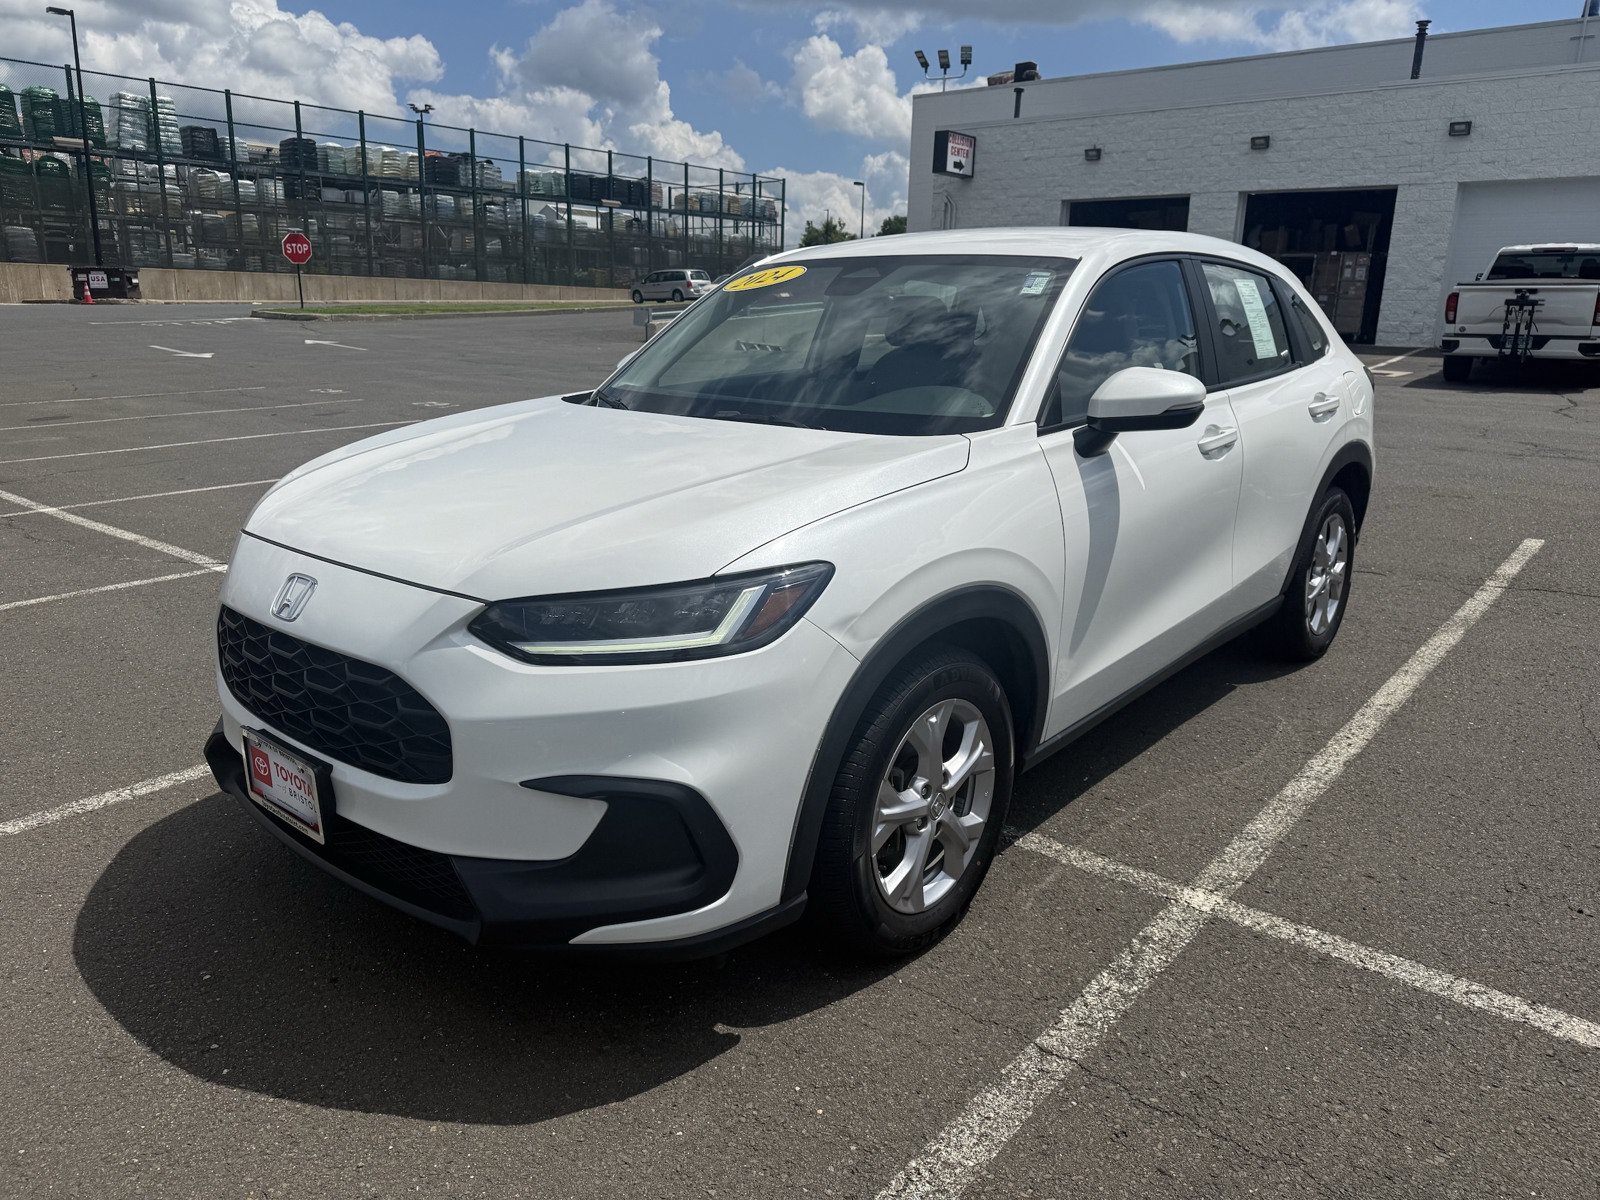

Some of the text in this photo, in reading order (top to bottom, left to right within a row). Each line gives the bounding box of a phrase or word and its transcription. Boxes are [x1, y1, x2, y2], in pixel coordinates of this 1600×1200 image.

[949, 133, 973, 149] COLLISION
[951, 146, 969, 159] CENTER
[286, 243, 309, 254] STOP
[731, 268, 797, 289] 2024
[273, 760, 315, 800] TOYOTA
[288, 787, 317, 814] BRISTOL
